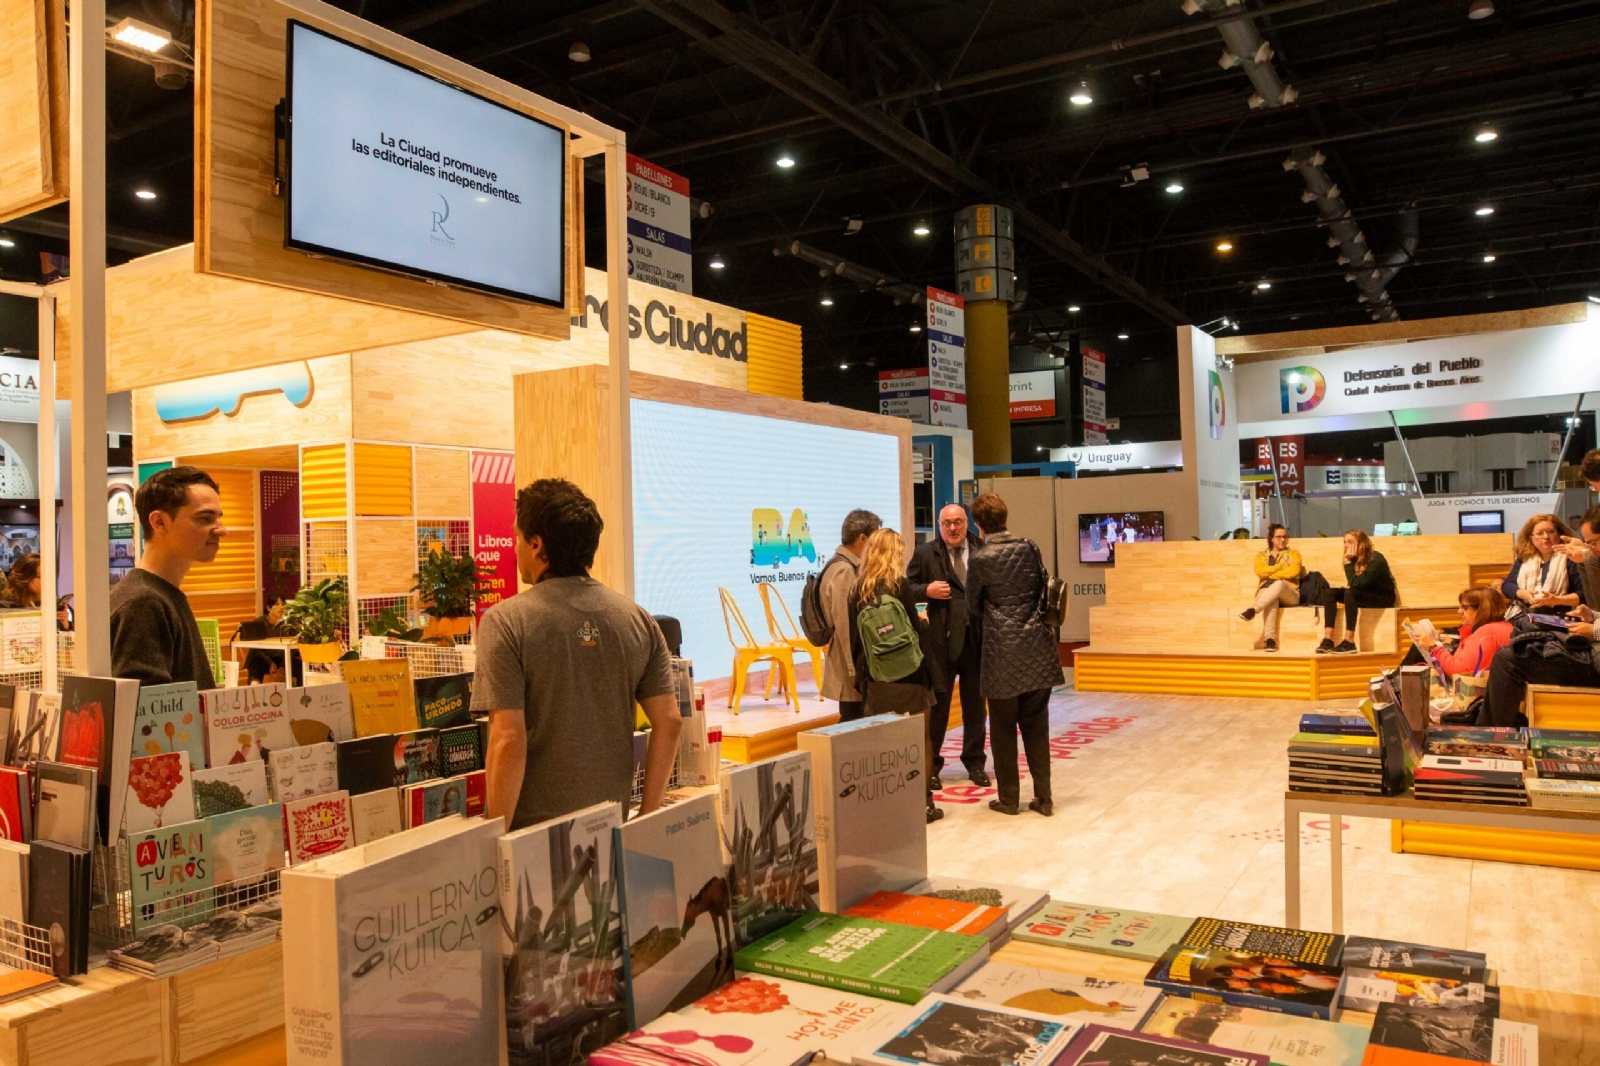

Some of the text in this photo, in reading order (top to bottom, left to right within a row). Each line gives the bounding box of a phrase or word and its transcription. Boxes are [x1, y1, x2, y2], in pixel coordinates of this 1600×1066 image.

[380, 132, 498, 182] La Ciudad promueve
[352, 138, 522, 204] las editoriales independientes.
[636, 163, 672, 188] PABELLONES
[646, 227, 666, 244] SALAS
[636, 244, 652, 258] WALSH
[636, 260, 662, 276] GOROSTIZA
[666, 270, 684, 284] OCAMPO
[1344, 357, 1483, 383] Defensoría del Pueblo
[1344, 386, 1369, 396] Ciudad
[1414, 381, 1424, 389] de
[1427, 379, 1457, 388] Buenos
[1460, 376, 1484, 384] Aires
[1088, 452, 1132, 464] Uruguay
[1280, 442, 1298, 458] ES
[1280, 464, 1298, 478] PA
[1502, 496, 1540, 504] DERECHOS
[478, 534, 513, 548] Libros
[478, 551, 500, 564] que
[750, 574, 776, 584] Vamos
[778, 572, 804, 582] Buenos
[1074, 584, 1106, 595] DEFEN
[150, 697, 184, 716] Child
[424, 698, 446, 712] PACO
[425, 699, 462, 720] URONDO
[214, 716, 245, 728] COLOR
[247, 710, 284, 722] COCINA
[839, 744, 920, 784] GUILLERMO
[857, 773, 906, 805] KUITCA
[586, 822, 608, 834] TENSION
[666, 810, 710, 836] Pablo Suárez
[353, 866, 498, 952] GUILLERMO
[819, 928, 871, 958] SECRETO
[825, 927, 856, 944] ARTE
[387, 914, 476, 981] KUITCA
[829, 928, 888, 962] DEL ACTOR
[292, 1007, 332, 1020] GUILLERMO
[786, 1000, 858, 1041] HOY ME
[300, 1018, 324, 1028] KUITCA
[292, 1026, 334, 1040] COLLECTED
[294, 1036, 332, 1050] DRAWINGS
